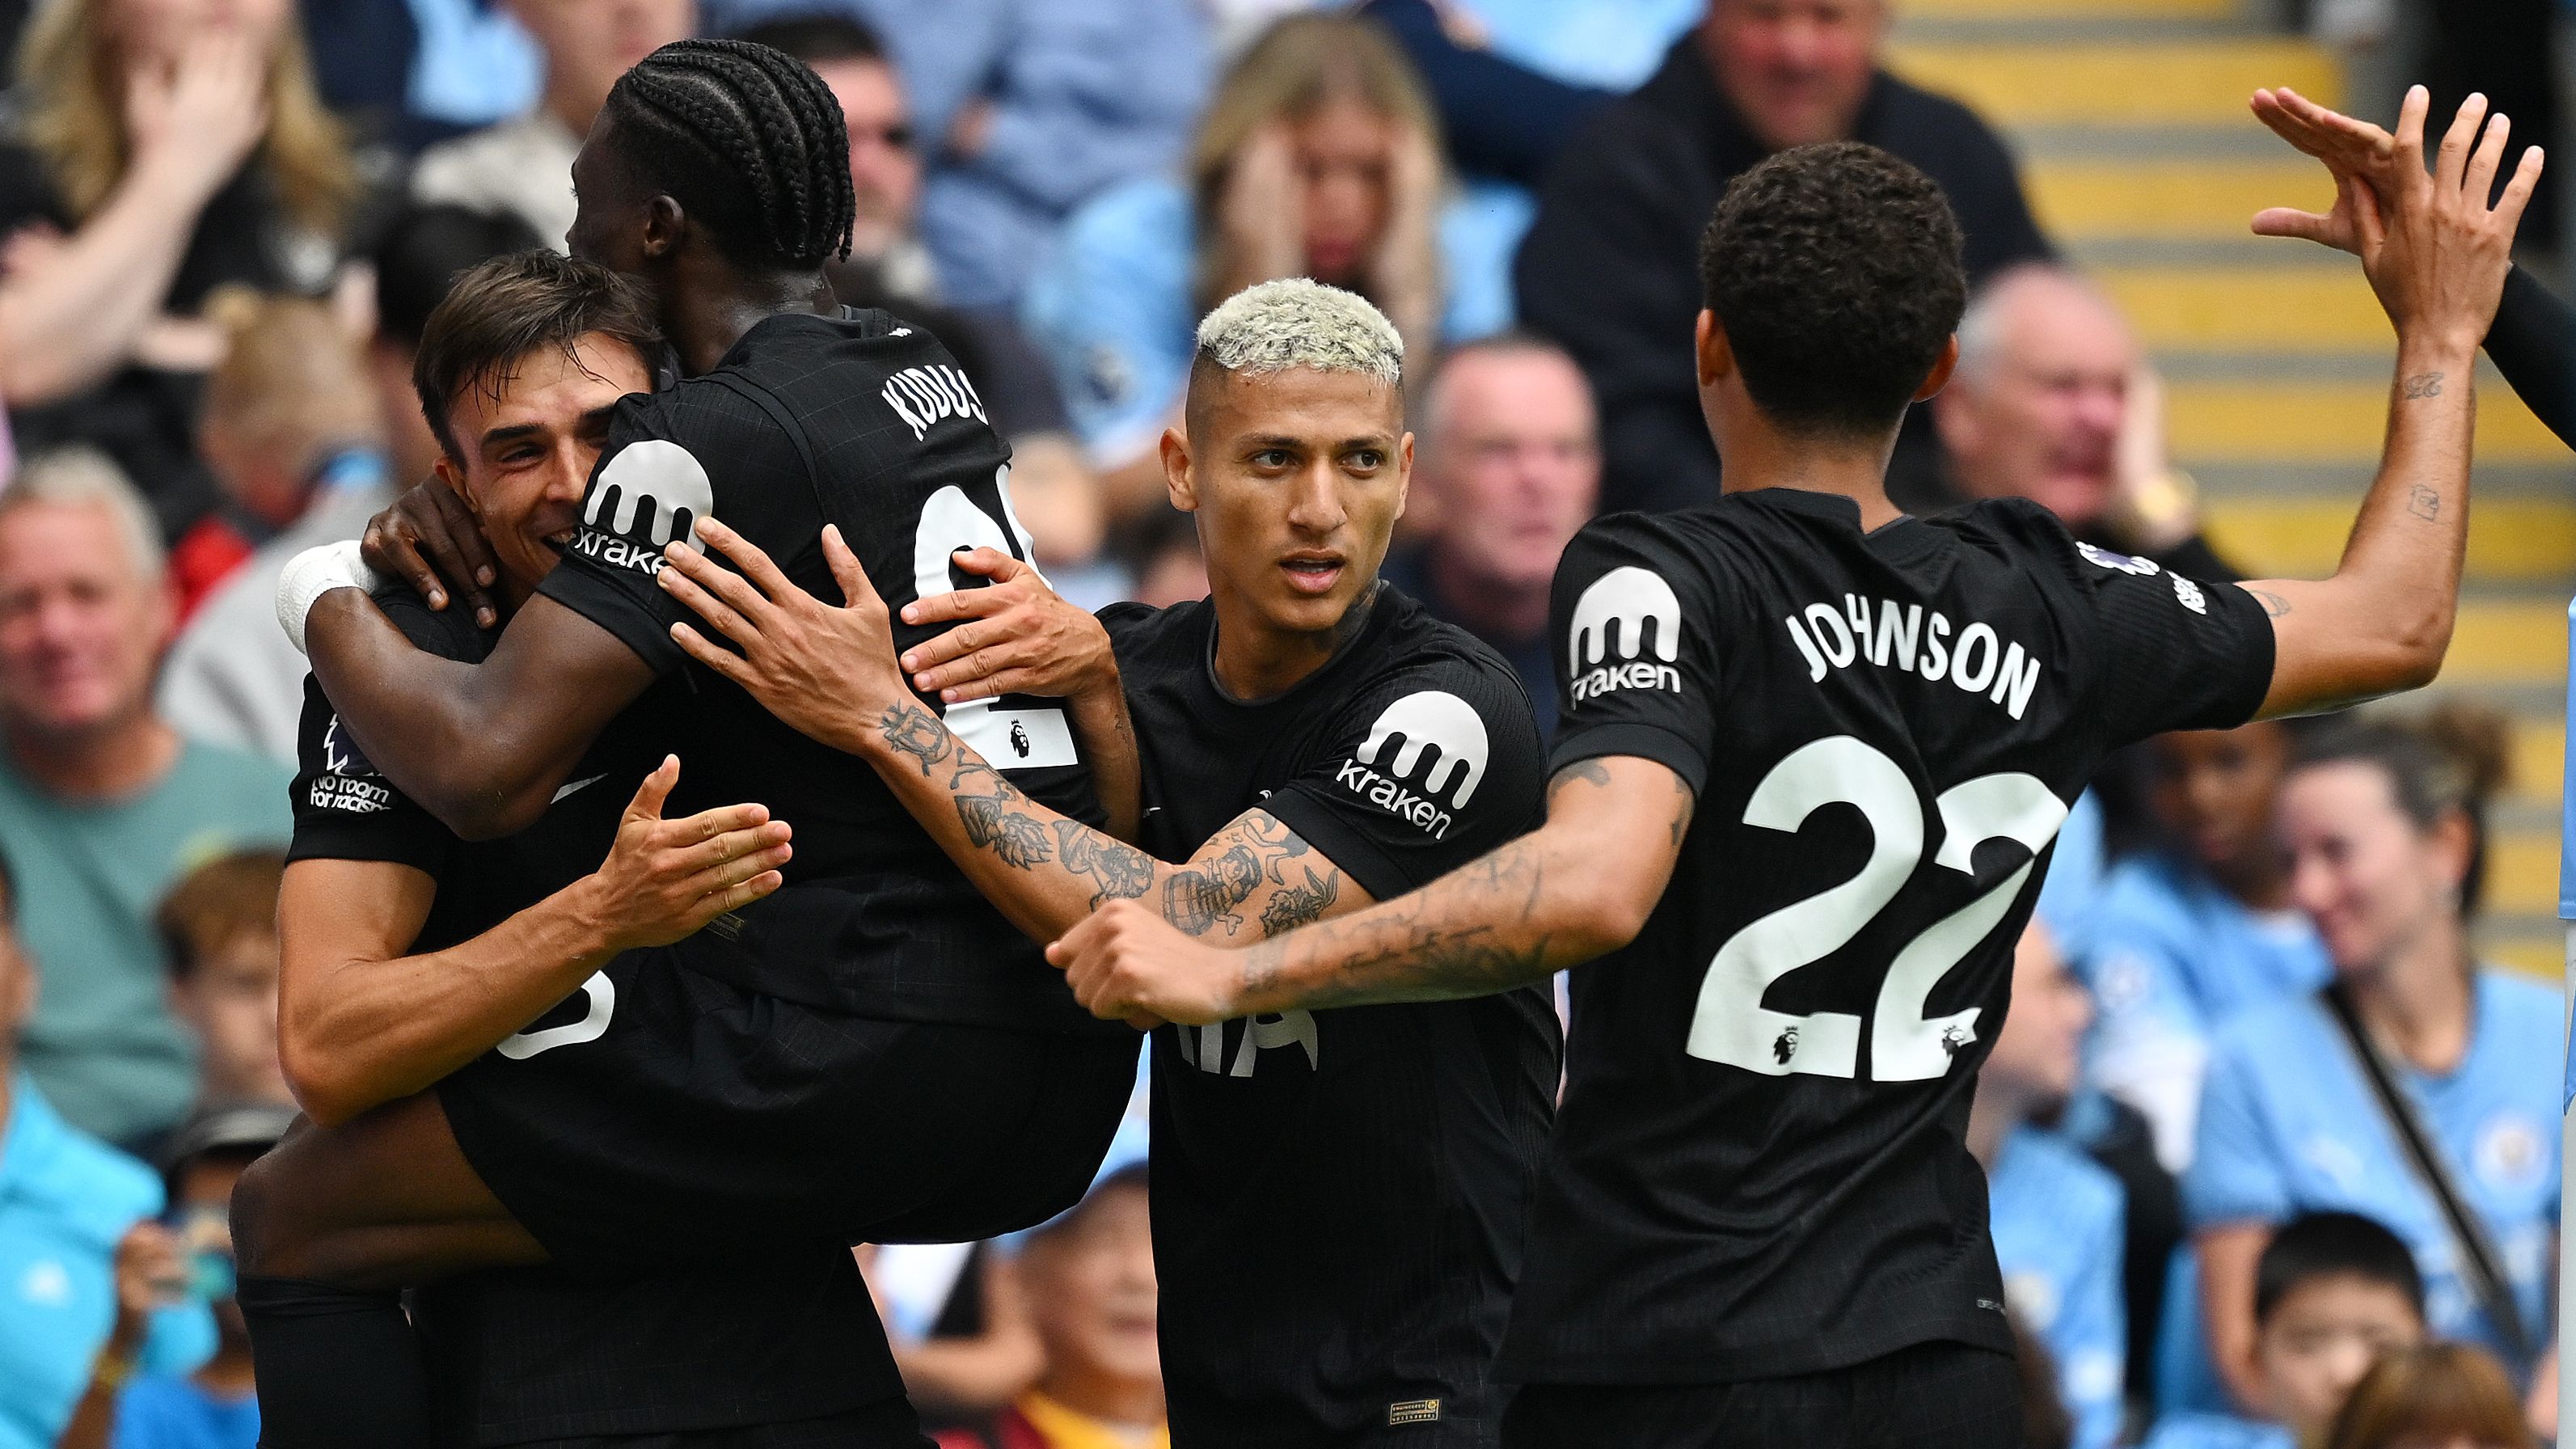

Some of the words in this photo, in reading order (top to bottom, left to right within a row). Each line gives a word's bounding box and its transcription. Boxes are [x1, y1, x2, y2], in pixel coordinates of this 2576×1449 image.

[881, 365, 989, 441] KUDUS
[1785, 593, 2041, 720] JOHNSON
[338, 776, 390, 804] room
[1336, 758, 1451, 840] kraken
[1686, 734, 2069, 1082] 22
